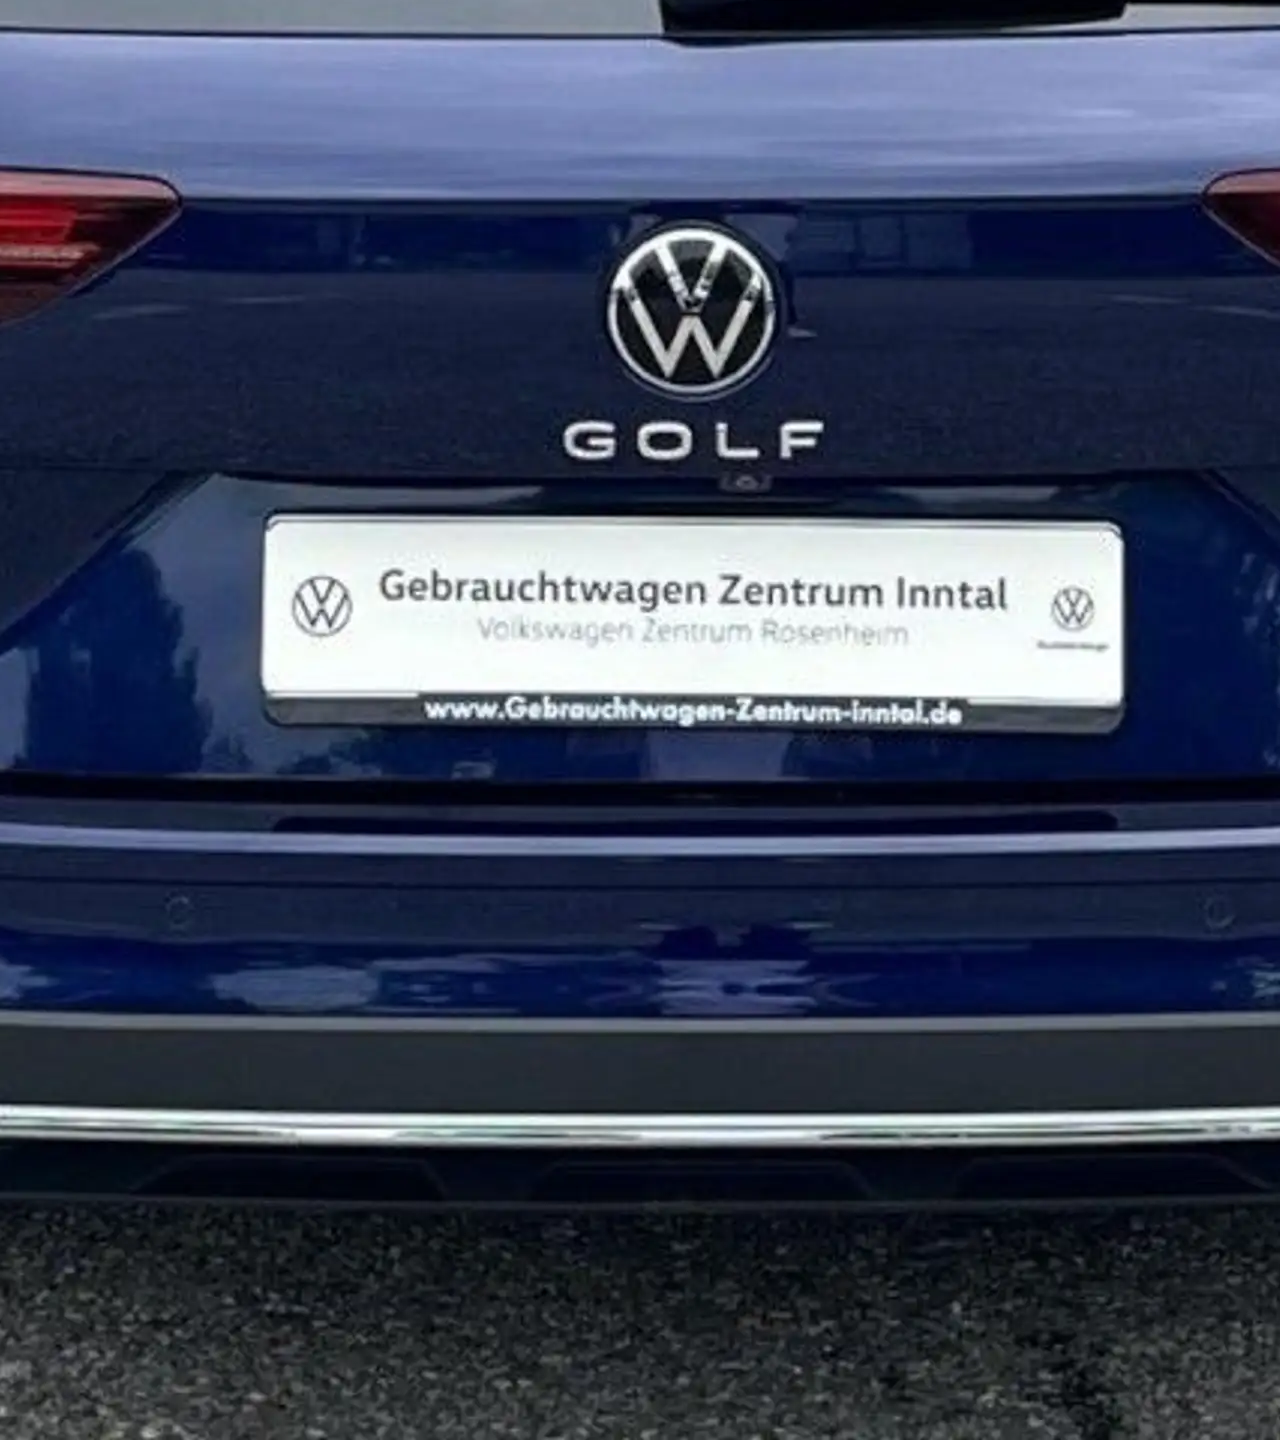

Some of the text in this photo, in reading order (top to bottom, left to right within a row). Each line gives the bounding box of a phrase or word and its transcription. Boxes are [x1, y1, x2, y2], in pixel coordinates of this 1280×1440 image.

[563, 420, 826, 462] GOLF
[378, 568, 1008, 614] Gebrauchtwagen Zentrum Inntal
[477, 616, 908, 646] Volkswagen Zentrum Rosenheim
[424, 696, 963, 728] www.Gebrauchtwagen-Zentrum-inntal.de
